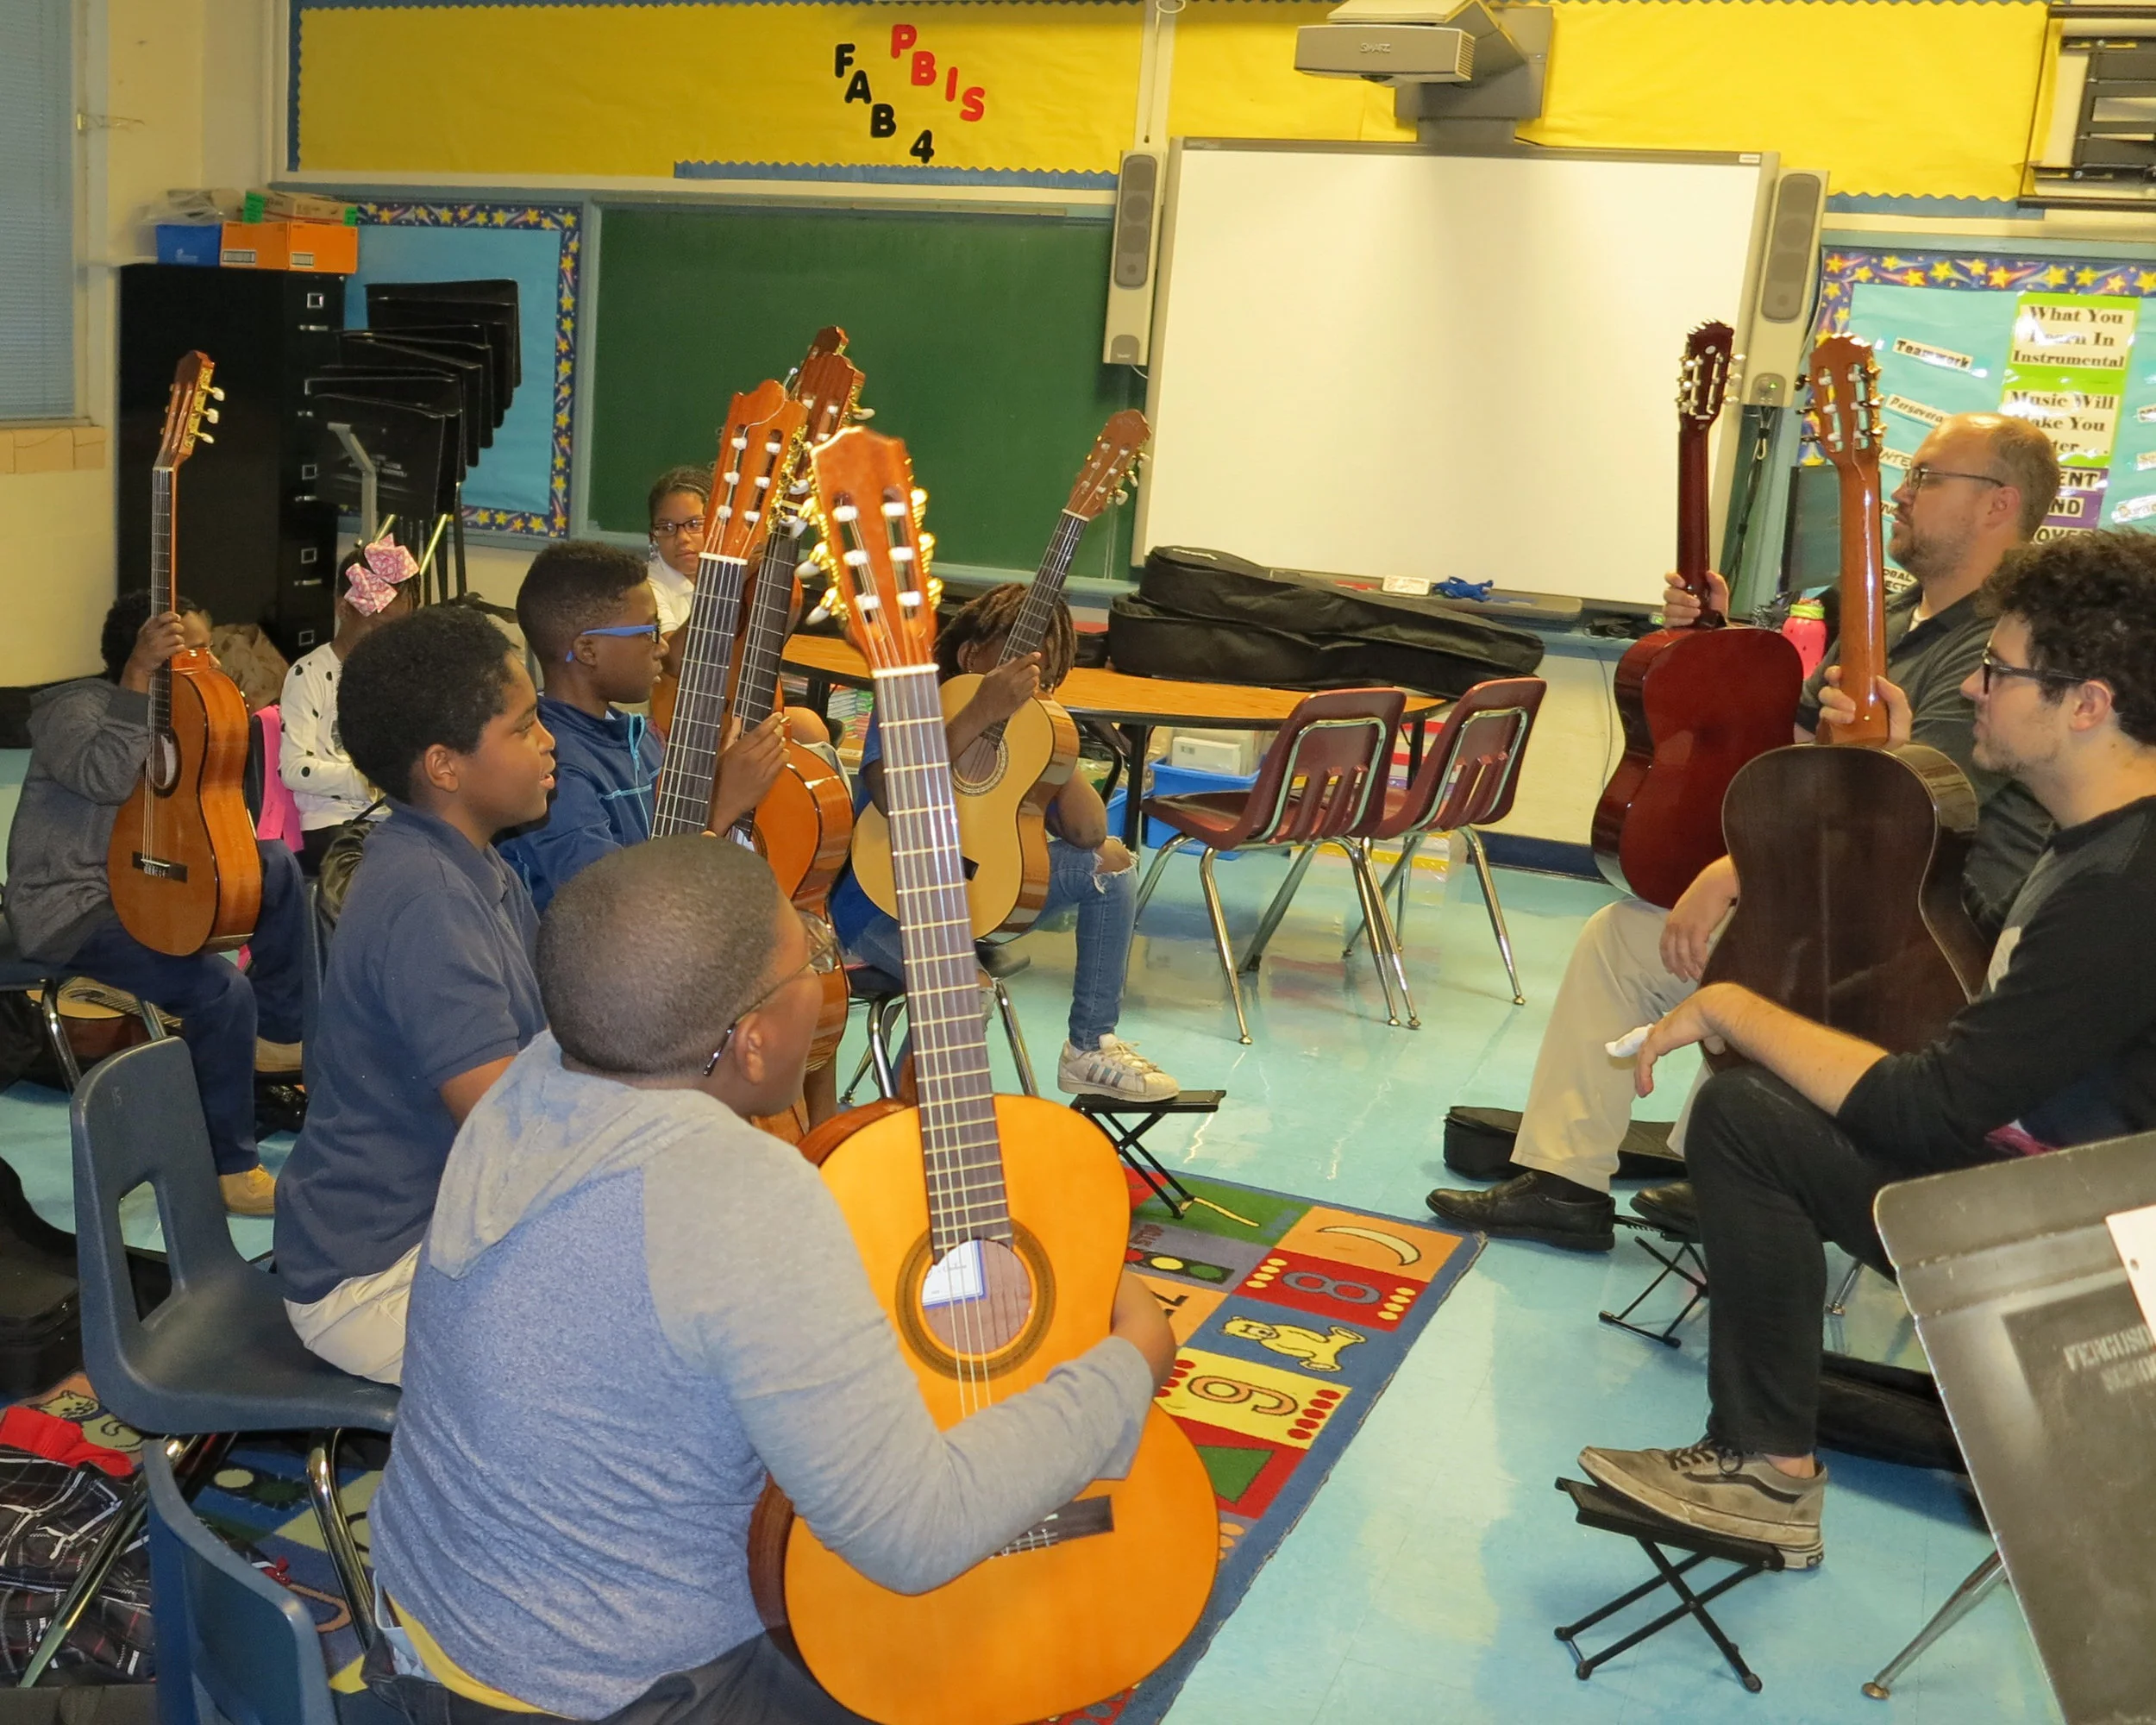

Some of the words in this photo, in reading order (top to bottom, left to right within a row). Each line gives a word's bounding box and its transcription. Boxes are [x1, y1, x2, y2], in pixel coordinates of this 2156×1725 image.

[891, 24, 986, 122] PBIS
[909, 129, 935, 164] 4
[2029, 306, 2081, 323] What
[2087, 309, 2123, 324] You
[2094, 331, 2115, 347] In
[2013, 350, 2125, 367] Instrumental
[2010, 391, 2068, 408] Music
[2073, 393, 2115, 410] Will
[1890, 397, 1945, 423] Persevera
[2027, 415, 2064, 430] ake
[2069, 417, 2105, 432] You
[2052, 441, 2080, 453] ter
[2059, 471, 2098, 488] ENT
[2050, 499, 2081, 515] ND
[1281, 1271, 1382, 1305] 8
[2063, 1324, 2153, 1372] FERGUSO
